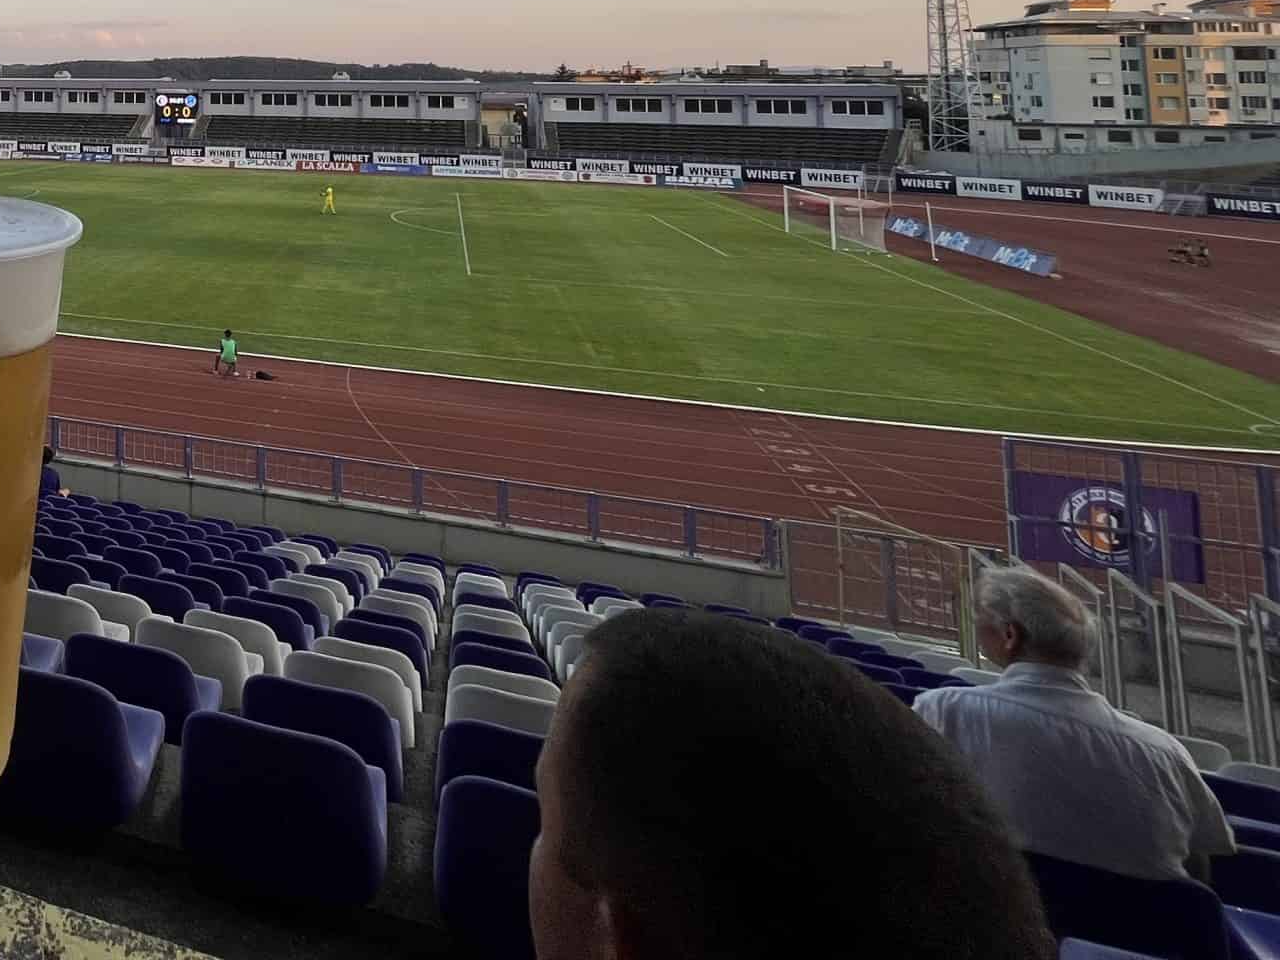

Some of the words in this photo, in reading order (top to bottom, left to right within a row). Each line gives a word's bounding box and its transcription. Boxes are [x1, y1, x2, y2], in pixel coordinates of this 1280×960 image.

[170, 148, 203, 157] WINBET
[209, 149, 242, 158] WINBET
[248, 151, 284, 159] WINBET
[291, 152, 325, 161] WINBET
[333, 154, 370, 163] WINBET
[376, 155, 416, 164] WINBET
[421, 156, 459, 165] WINBET
[463, 158, 500, 167] WINBET
[531, 160, 572, 169] WINBET
[581, 162, 624, 172] WINBET
[633, 164, 679, 174] WINBET
[688, 167, 737, 177] WINBET
[746, 168, 796, 180] WINBET
[808, 172, 858, 184] WINBET
[901, 177, 951, 189] WINBET
[962, 182, 1015, 193] WINBET
[1026, 185, 1083, 199] WINBET
[1095, 191, 1154, 203] WINBET
[1213, 198, 1280, 213] WINBET
